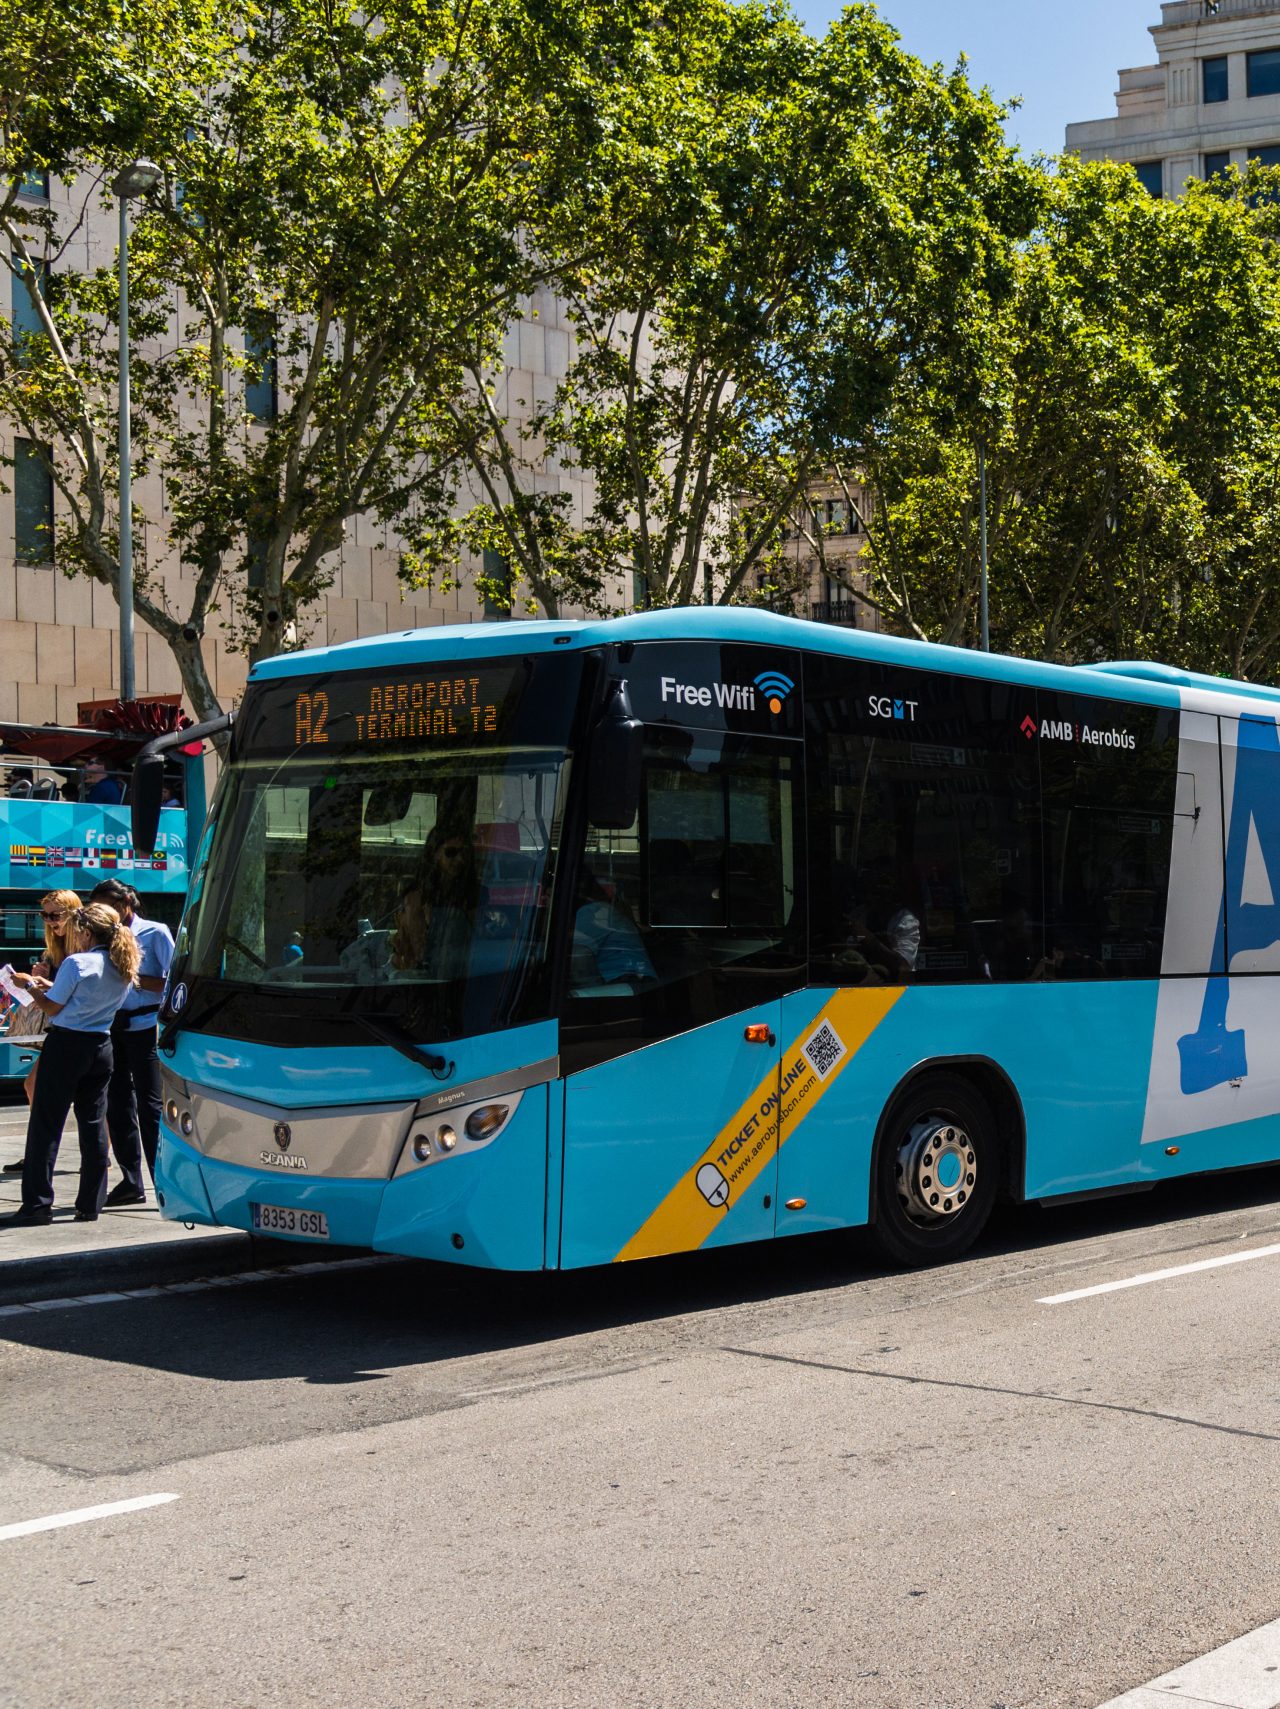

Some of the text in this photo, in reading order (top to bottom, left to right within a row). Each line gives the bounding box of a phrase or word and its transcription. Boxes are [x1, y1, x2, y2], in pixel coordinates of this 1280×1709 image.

[371, 678, 479, 711] AEROPORT
[661, 676, 755, 711] Free Wifi
[296, 691, 329, 744] A2
[355, 705, 497, 740] TERMINAL T2
[1040, 719, 1136, 750] AMB Aerobús
[438, 1090, 465, 1104] Magnus
[717, 1113, 763, 1167] TICKET
[729, 1075, 817, 1183] www.aerobusbcn.com
[260, 1151, 308, 1169] SCANIA
[262, 1208, 328, 1235] 8353 GSL
